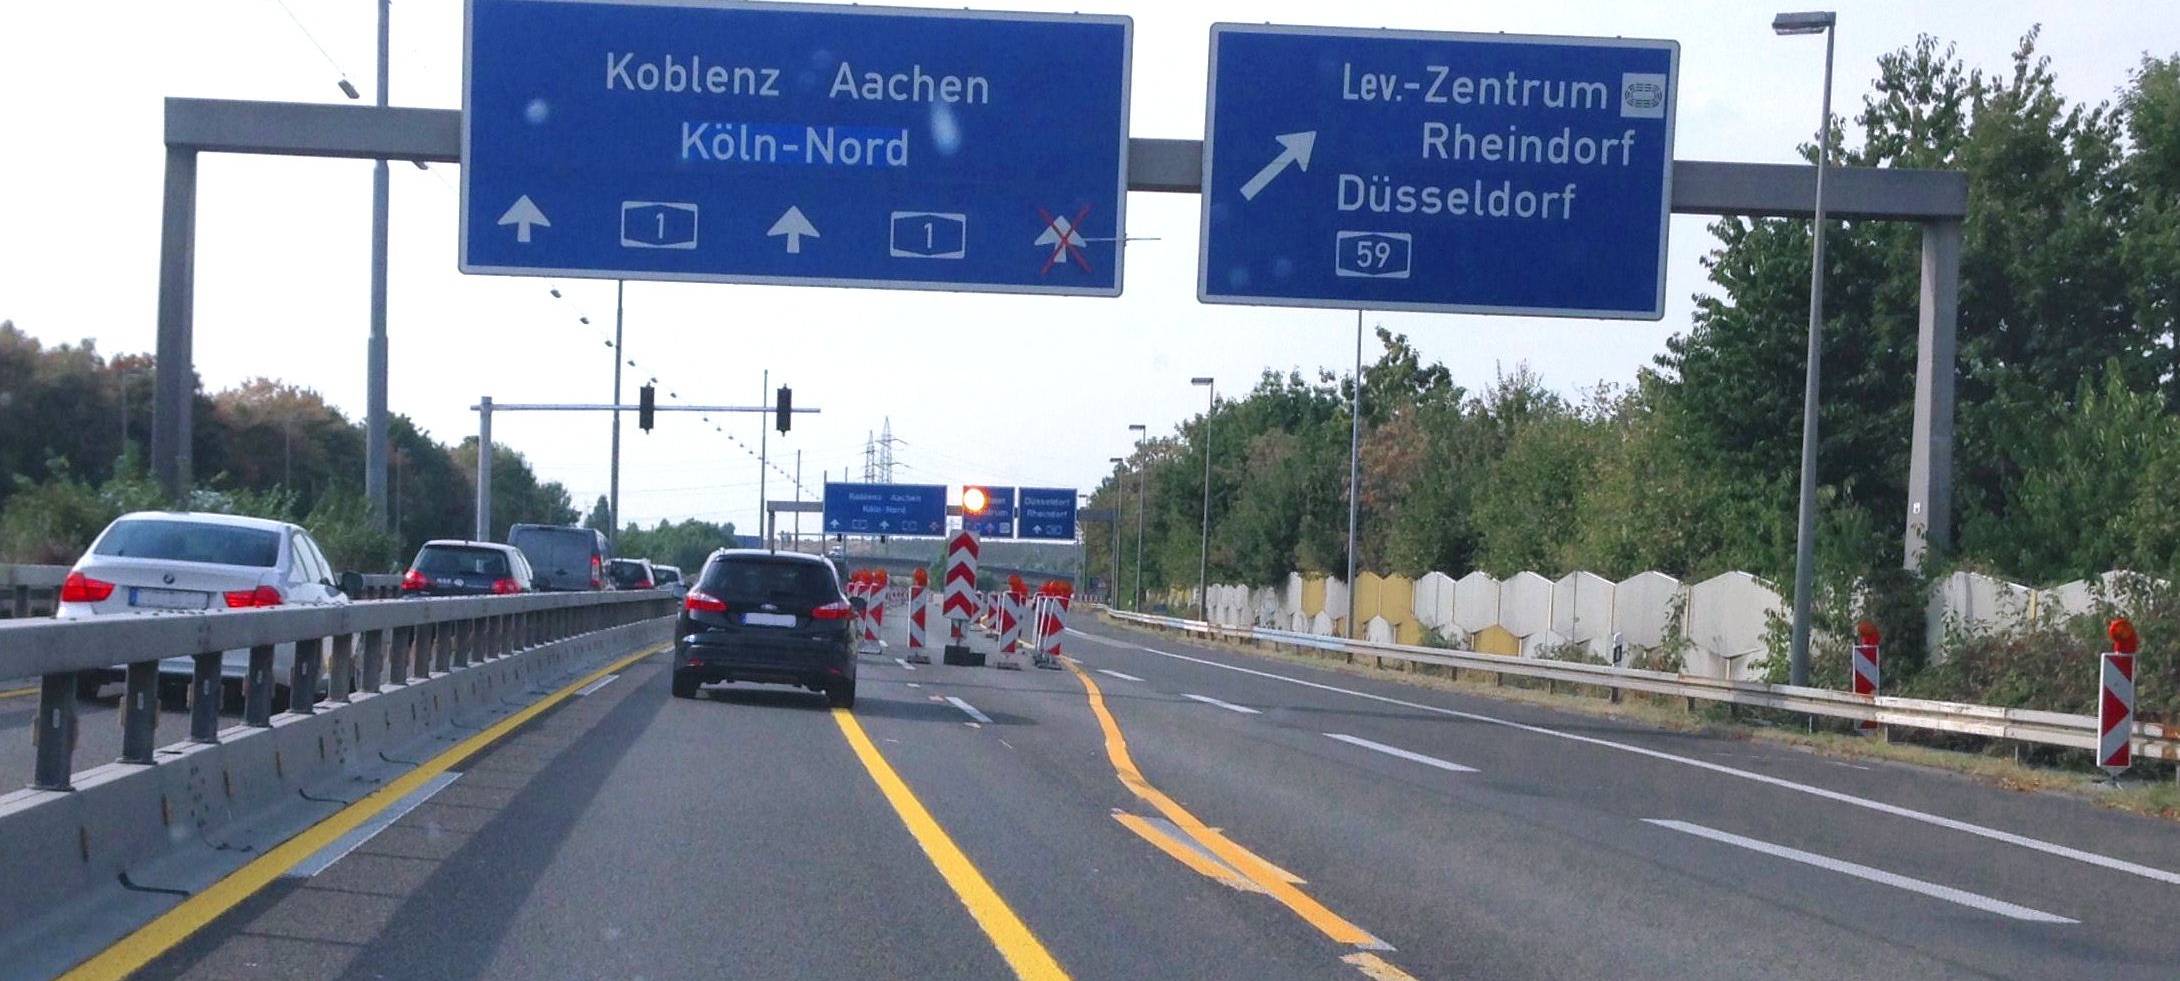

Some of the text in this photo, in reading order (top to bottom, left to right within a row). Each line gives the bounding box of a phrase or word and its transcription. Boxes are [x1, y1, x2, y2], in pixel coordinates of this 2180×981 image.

[606, 52, 989, 104] Koblenz Aachen
[1343, 62, 1608, 110] Lev.-Zentrum
[681, 121, 908, 167] Köln-Nord
[1422, 121, 1636, 166] Rheindorf
[1337, 173, 1577, 219] Düsseldorf
[655, 212, 665, 240] 1
[923, 221, 933, 248] 1
[1356, 241, 1391, 268] 59
